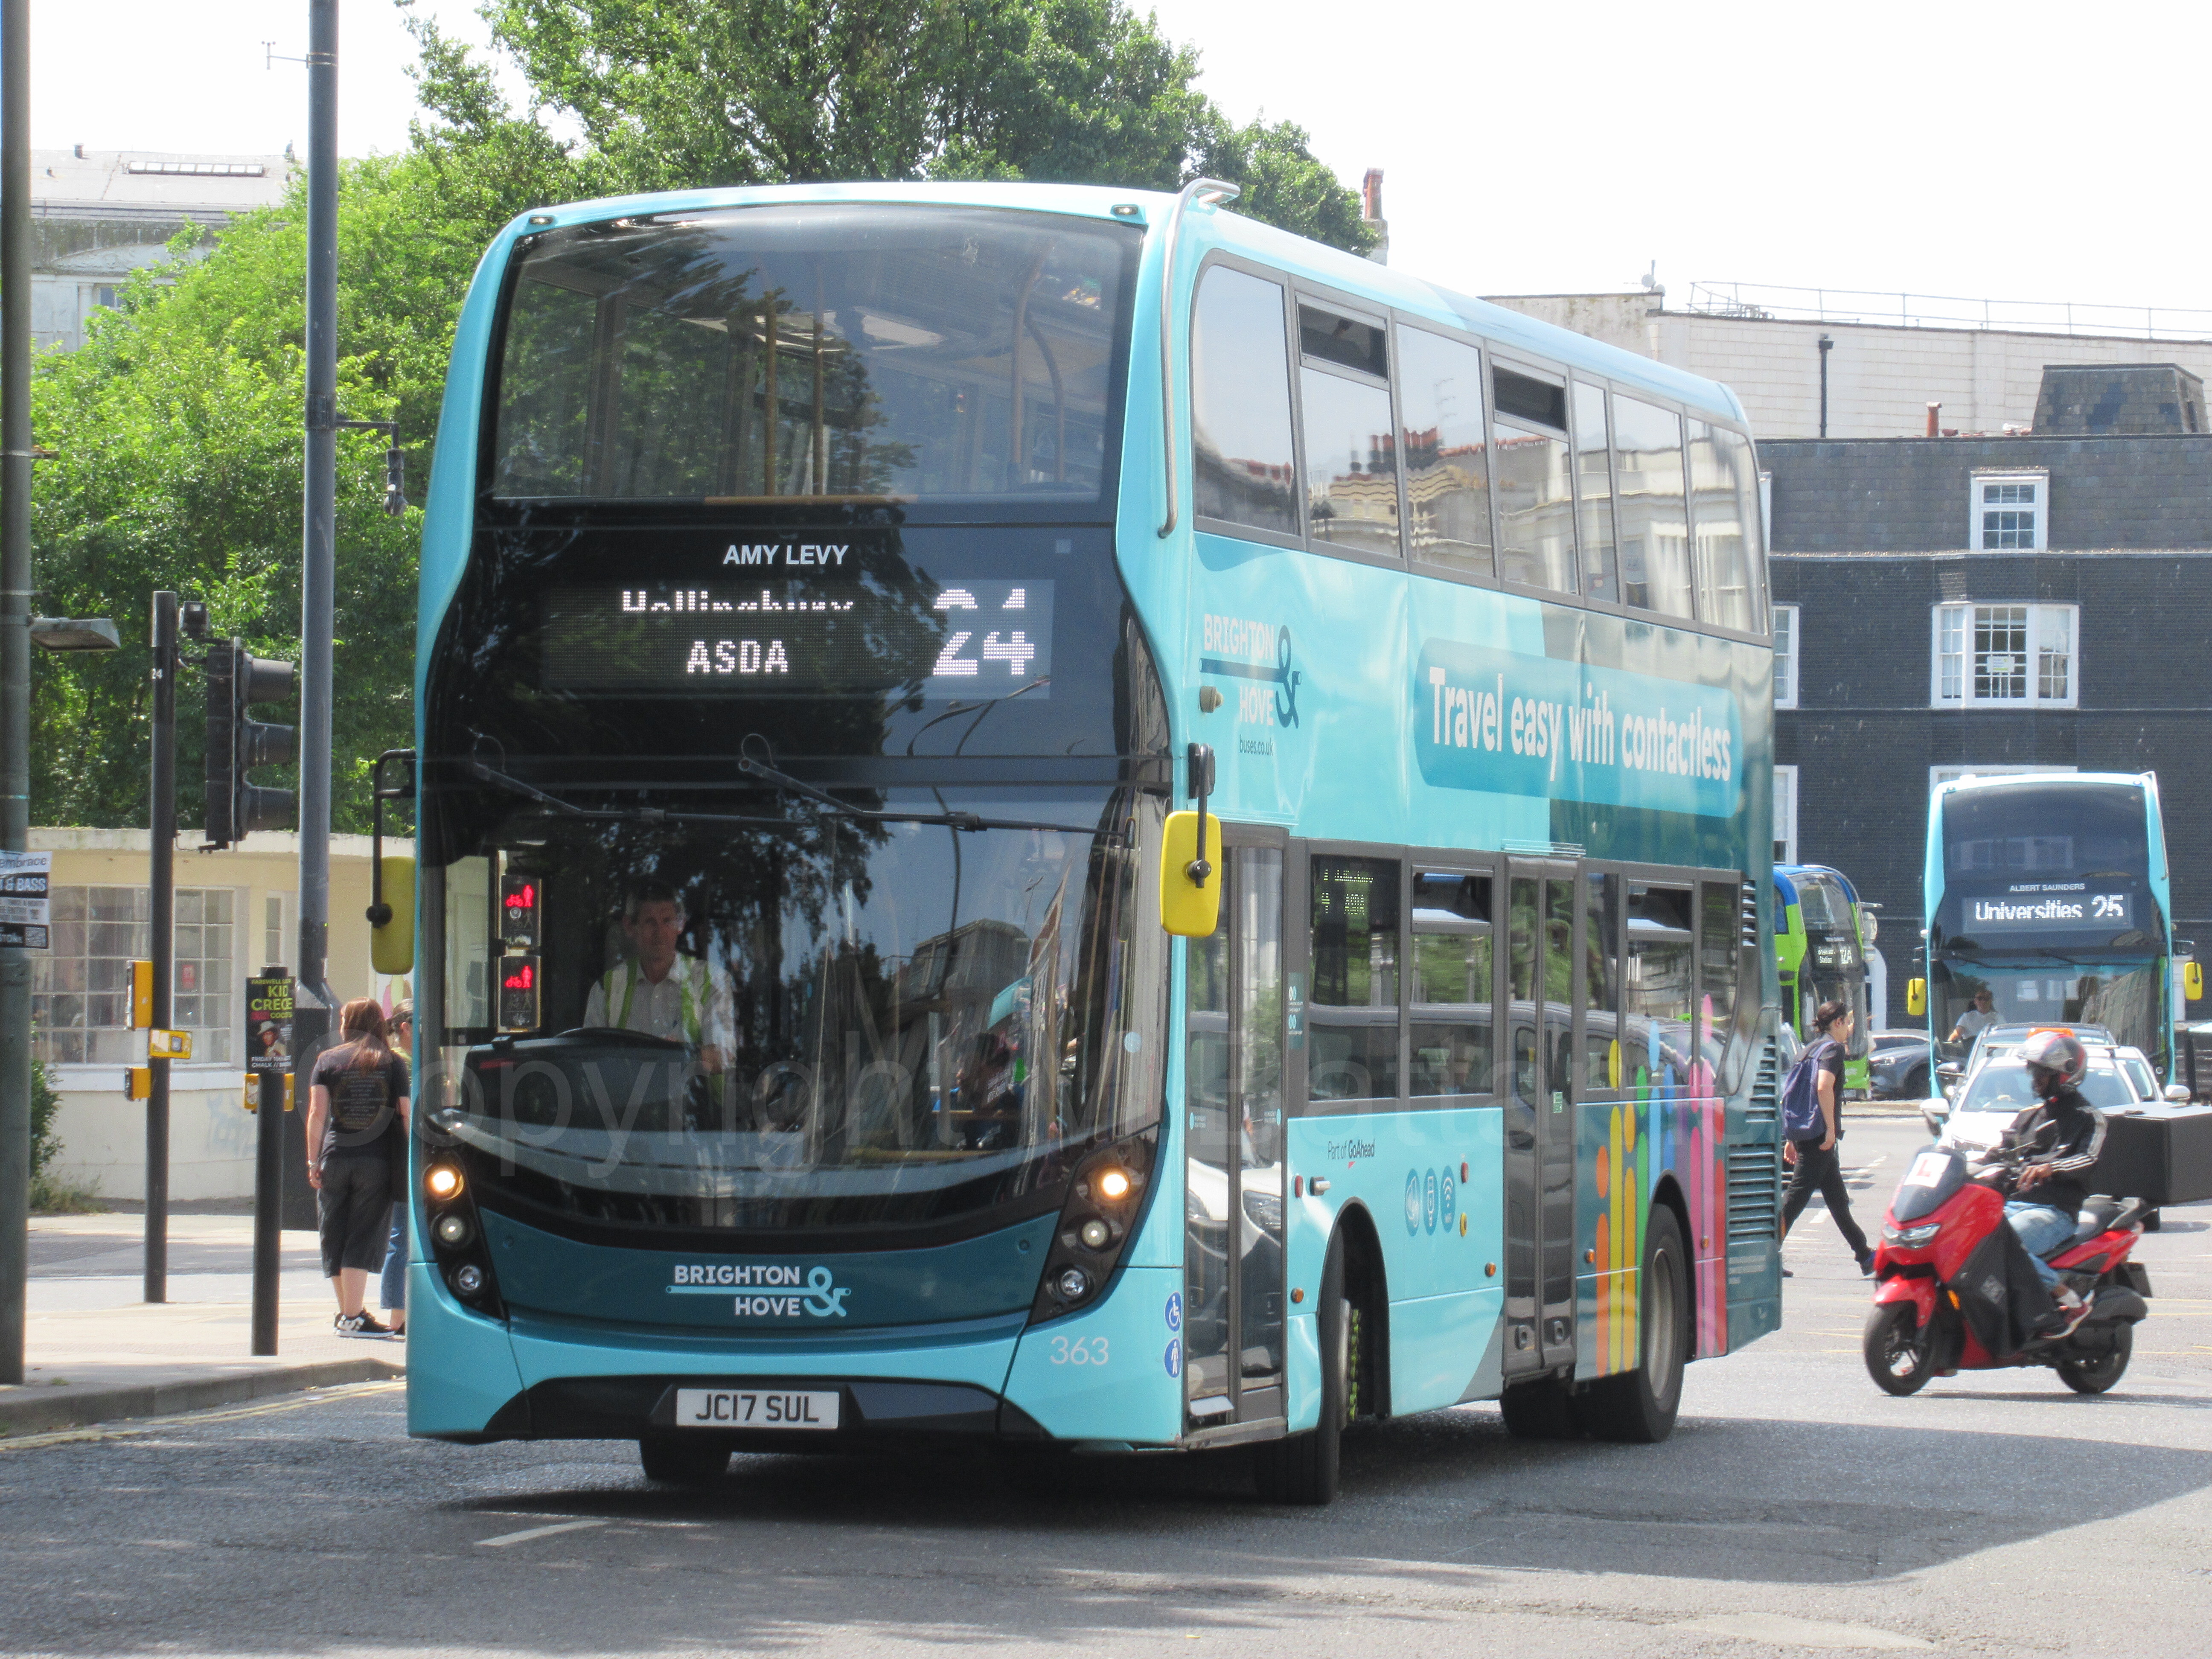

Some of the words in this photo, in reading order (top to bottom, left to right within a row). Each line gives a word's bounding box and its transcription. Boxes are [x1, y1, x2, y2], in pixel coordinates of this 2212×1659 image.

[723, 544, 780, 565] AMY
[786, 544, 849, 565] LEVY
[933, 588, 1035, 676] 24
[1204, 613, 1274, 661] BRIGHTON
[687, 640, 789, 673] ASDA
[1239, 686, 1274, 726] HOVE
[1429, 667, 1503, 751] Travel
[1511, 696, 1563, 781] easy
[1568, 682, 1614, 765] with
[1622, 706, 1731, 781] contactless
[1239, 734, 1274, 756] buses.co.uk
[17, 877, 47, 891] BASS
[1975, 899, 2083, 920] Universities
[2091, 894, 2124, 917] 25
[268, 985, 288, 998] KID
[1327, 1142, 1339, 1159] Part
[1341, 1140, 1347, 1159] of
[1348, 1138, 1375, 1159] GoAhead
[1916, 1159, 1932, 1177] L
[674, 1265, 800, 1285] BRIGHTON
[734, 1297, 800, 1316] HOVE
[1050, 1336, 1109, 1365] 363
[696, 1394, 757, 1421] JC17
[765, 1395, 820, 1423] SUL
